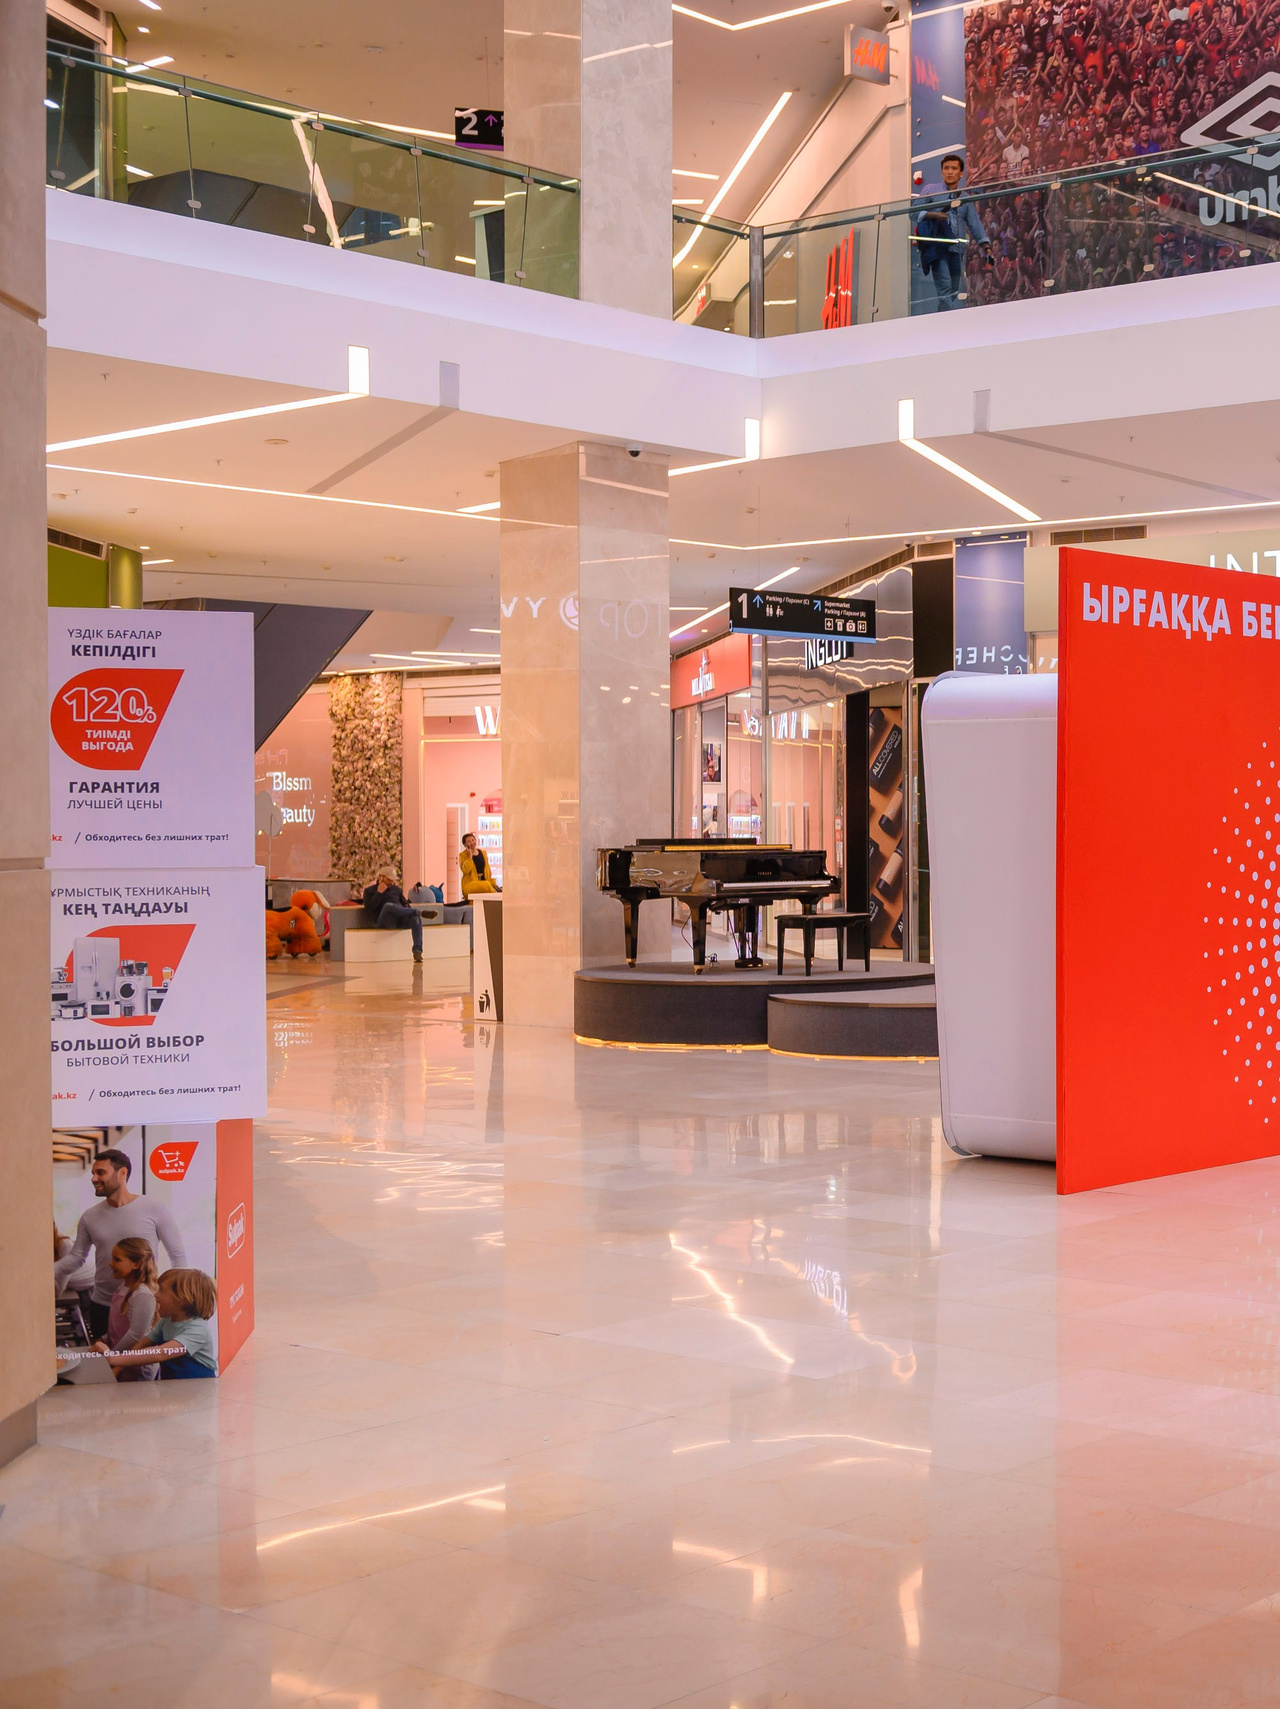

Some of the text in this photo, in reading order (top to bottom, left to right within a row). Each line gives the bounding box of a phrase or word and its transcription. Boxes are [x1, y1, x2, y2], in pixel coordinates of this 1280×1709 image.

[853, 37, 888, 73] H&M
[461, 113, 479, 136] 2
[737, 592, 748, 619] 1
[1082, 582, 1232, 642] ЫРҒАҚҚА
[67, 628, 162, 640] ҮЗДІК БАҒАЛАР
[71, 644, 156, 661] КЕПІЛДІГІ
[62, 687, 157, 724] 120%
[85, 729, 131, 741] ТИІМДІ
[81, 741, 134, 753] ВЫГОДА
[69, 781, 160, 794] ГАРАНТИЯ
[272, 771, 312, 791] Blssm
[67, 797, 163, 812] ЛУЧШЕЙ ЦЕНЫ
[282, 804, 315, 827] auty
[85, 833, 143, 843] Обходитесь
[145, 833, 162, 842] без
[163, 834, 203, 842] лишних
[205, 833, 229, 843] трат!
[124, 885, 210, 897] ТЕХНИКАНЫҢ
[63, 902, 188, 918] КЕҢ ТАҢДАУЫ
[51, 1034, 205, 1052] БОЛЬШОЙ ВЫБОР
[67, 1053, 190, 1068] БЫТОВОЙ ТЕХНИКИ
[99, 1089, 156, 1099] Обходитесь
[158, 1087, 175, 1096] без
[177, 1086, 215, 1095] лишних
[217, 1084, 241, 1094] трат!
[103, 1349, 121, 1358] без
[122, 1347, 161, 1357] лишних
[164, 1345, 187, 1356] трат!
